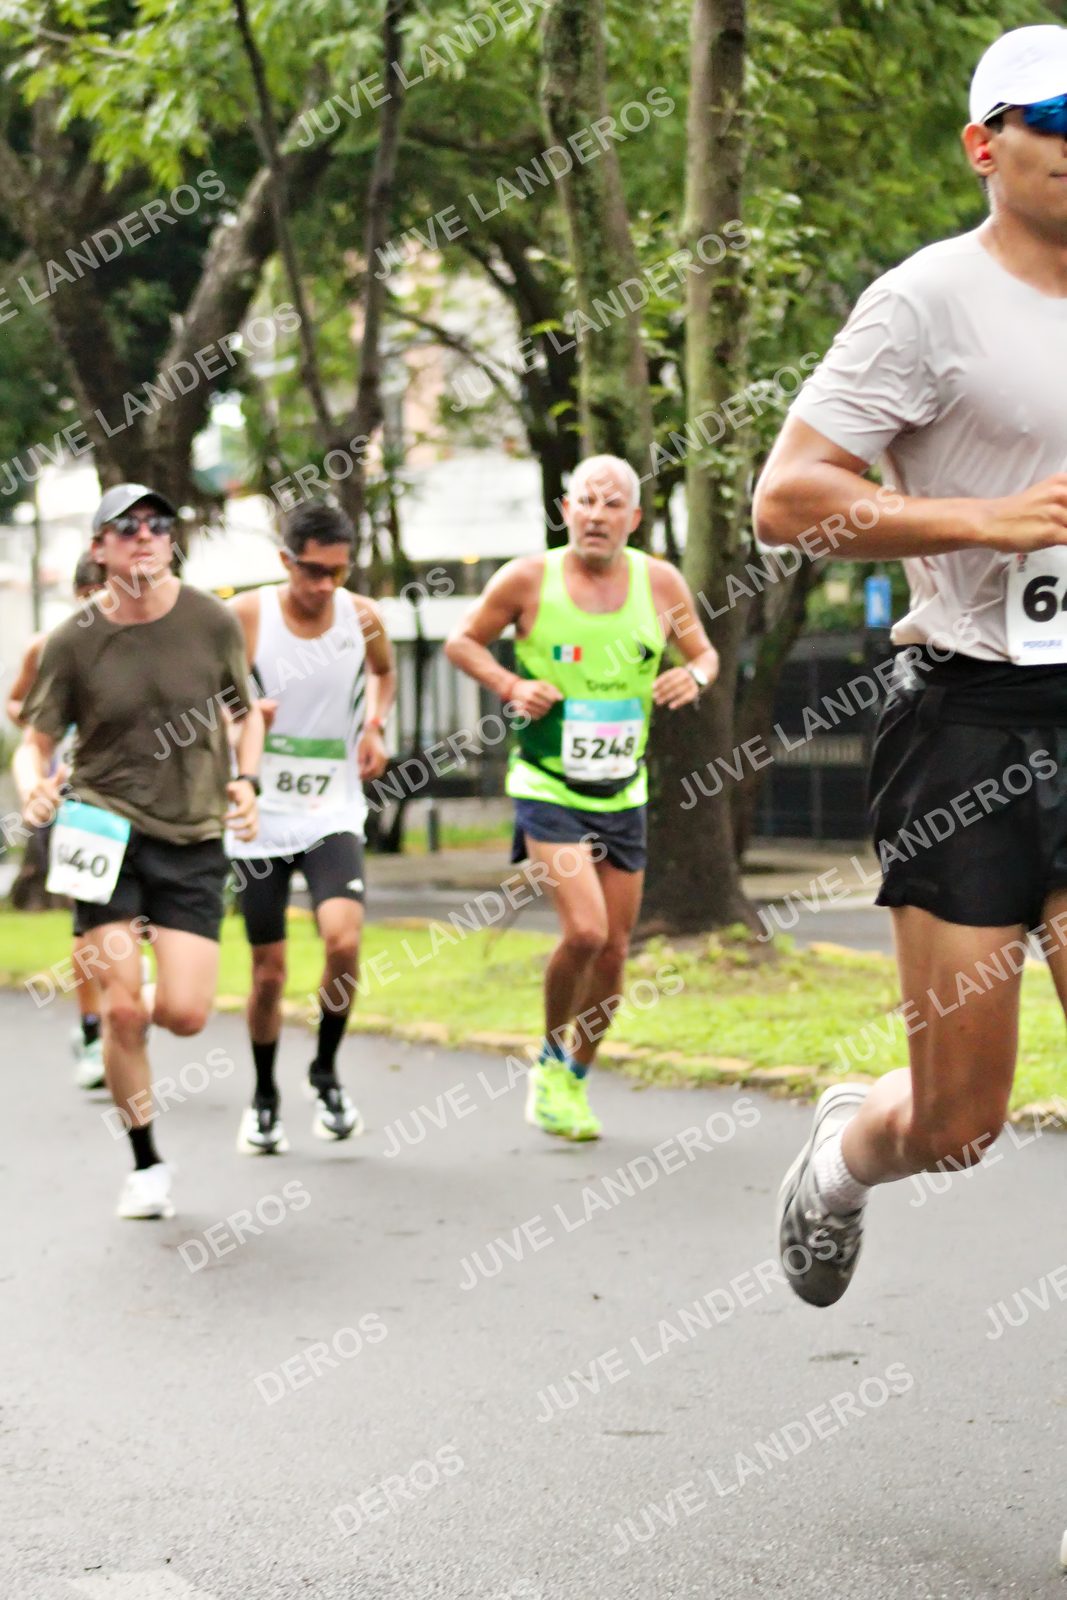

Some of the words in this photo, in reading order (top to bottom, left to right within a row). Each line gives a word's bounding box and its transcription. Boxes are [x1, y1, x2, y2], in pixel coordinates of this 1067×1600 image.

[1022, 575, 1067, 622] 6
[571, 736, 635, 760] 5248
[276, 771, 332, 796] 867
